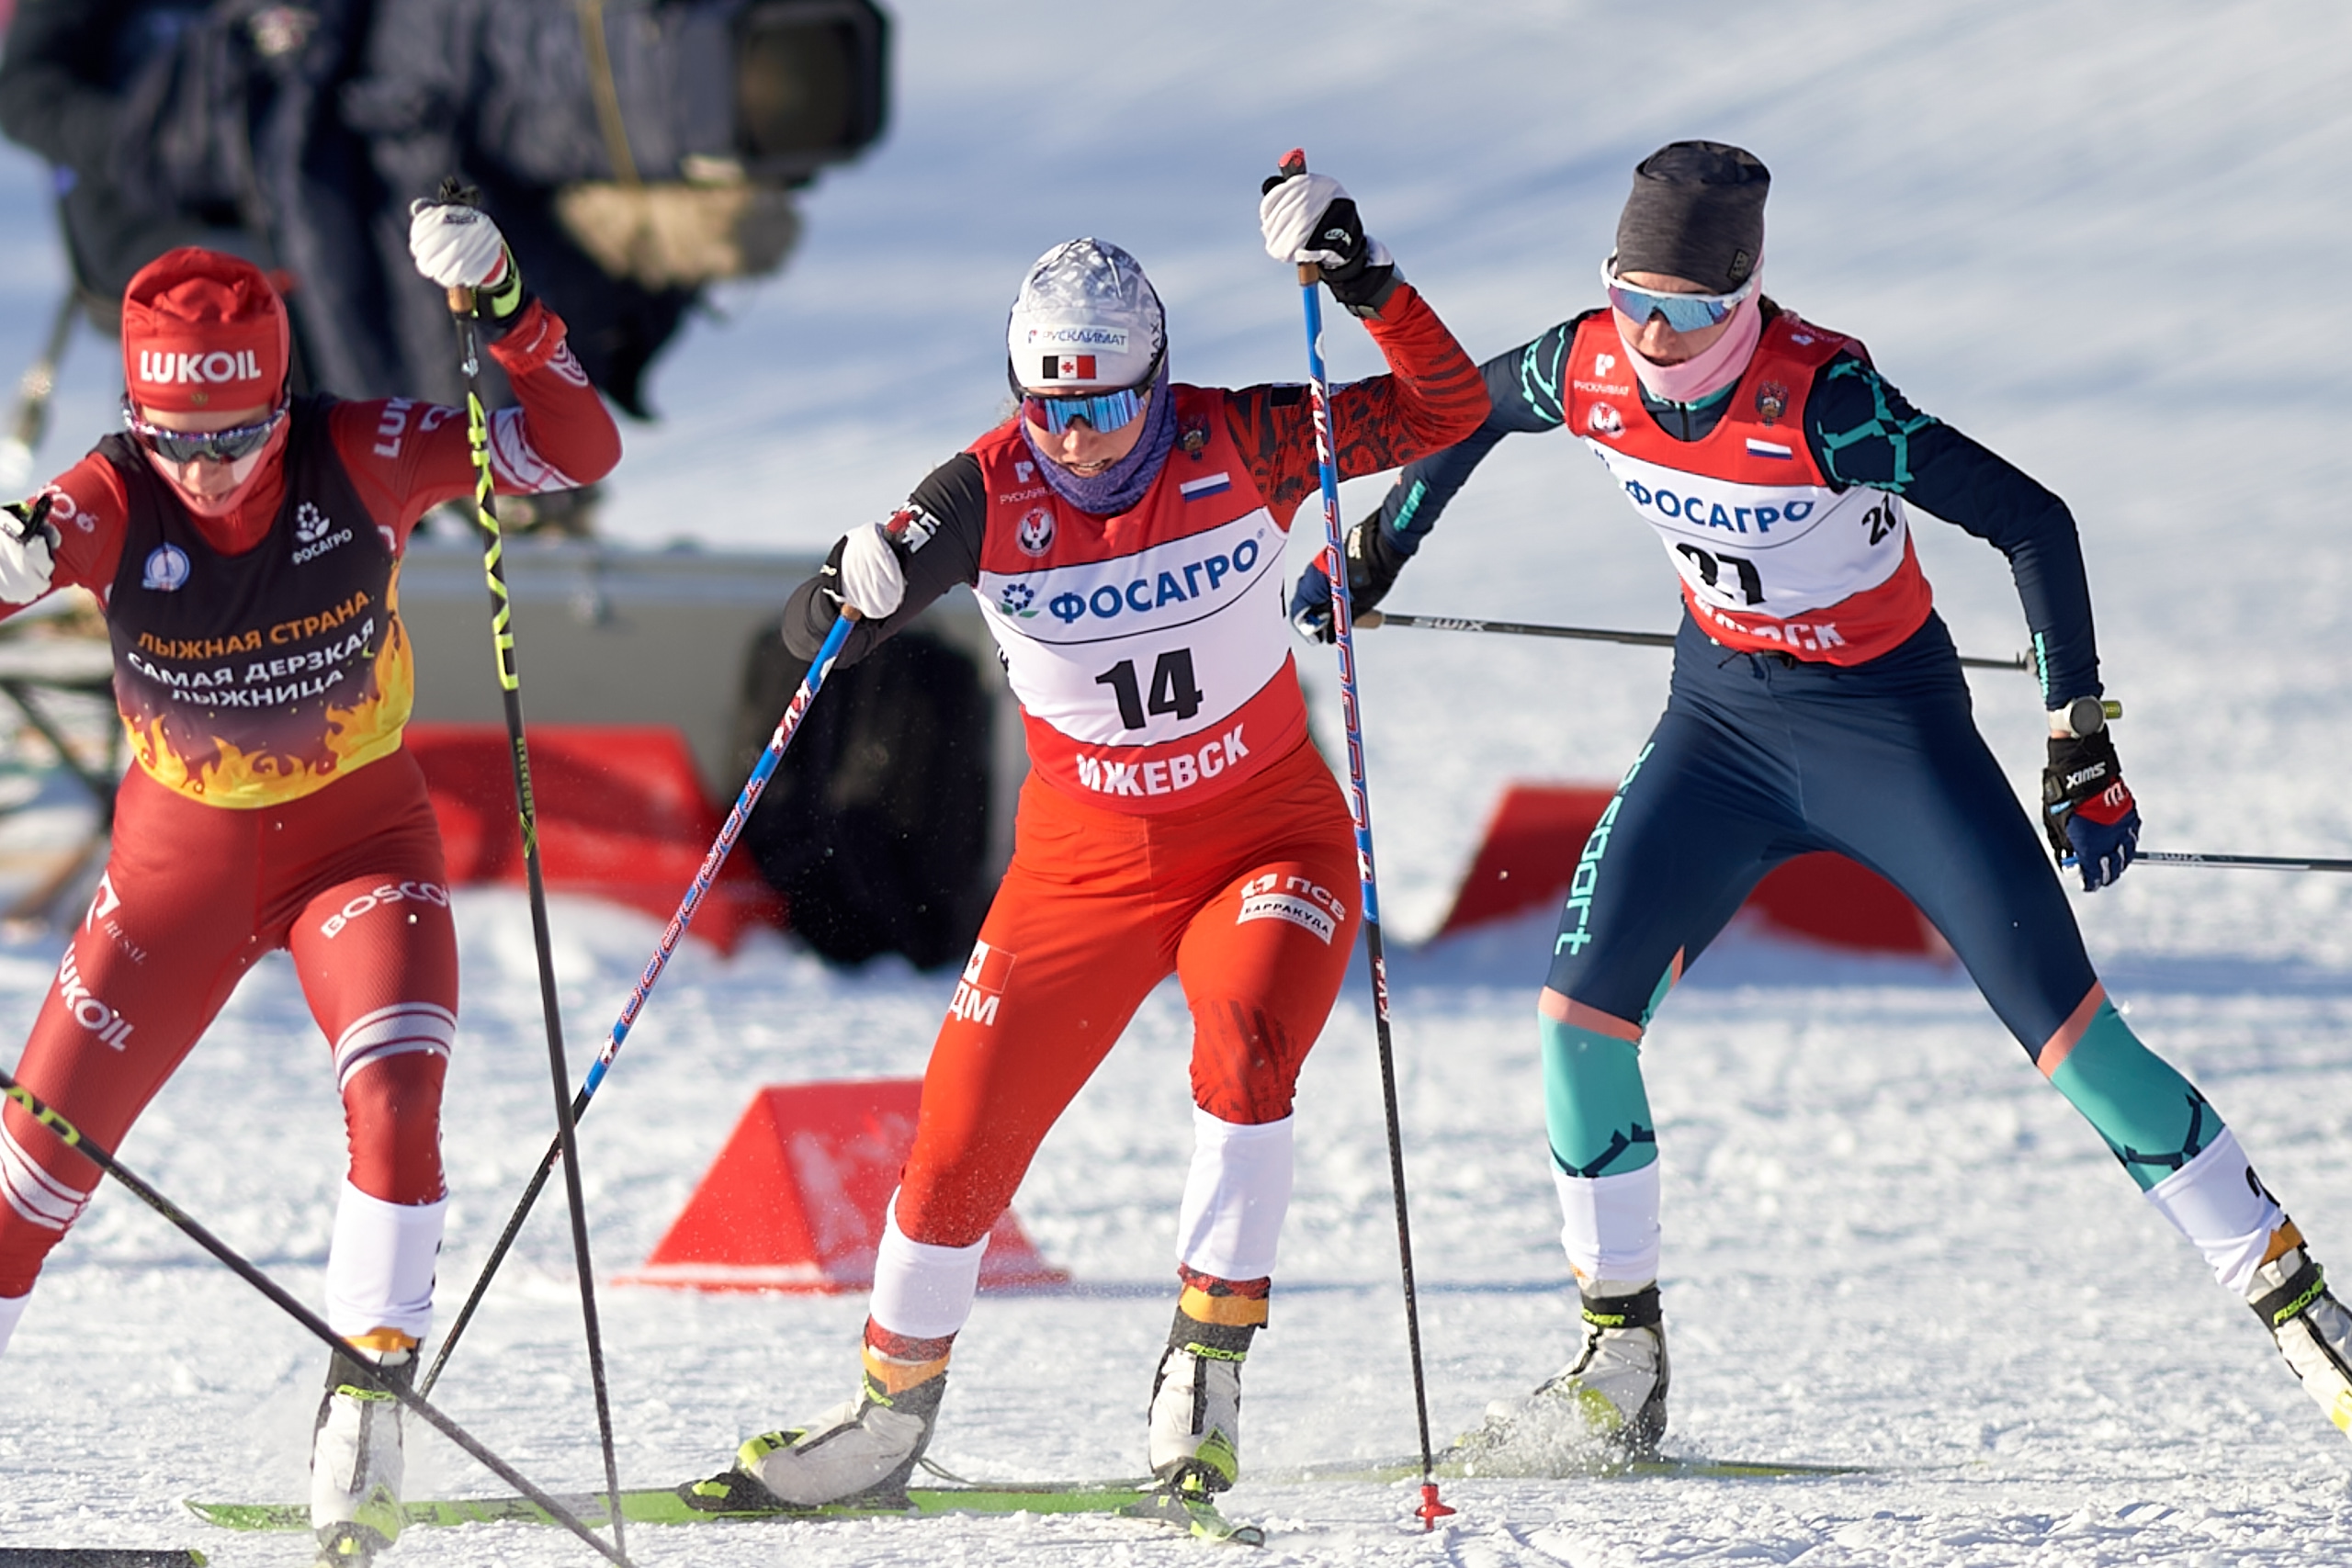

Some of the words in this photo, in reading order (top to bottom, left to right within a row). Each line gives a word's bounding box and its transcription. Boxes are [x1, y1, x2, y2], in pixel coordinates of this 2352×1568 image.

[141, 350, 262, 383] LUKOIL
[1625, 479, 1815, 534] ФОСАГРО
[1049, 538, 1259, 624] ФОСАГРО
[127, 651, 234, 689] САМАЯ
[243, 617, 375, 684] ДЕРЗКАЯ
[139, 629, 263, 660] ЛЫЖНАЯ
[269, 590, 369, 643] СТРАНА
[171, 670, 345, 707] ЛЫЖНИЦА
[1095, 648, 1204, 729] 14
[1076, 723, 1250, 796] ИЖЕВСК
[1244, 902, 1329, 934] БАРРАКУДА
